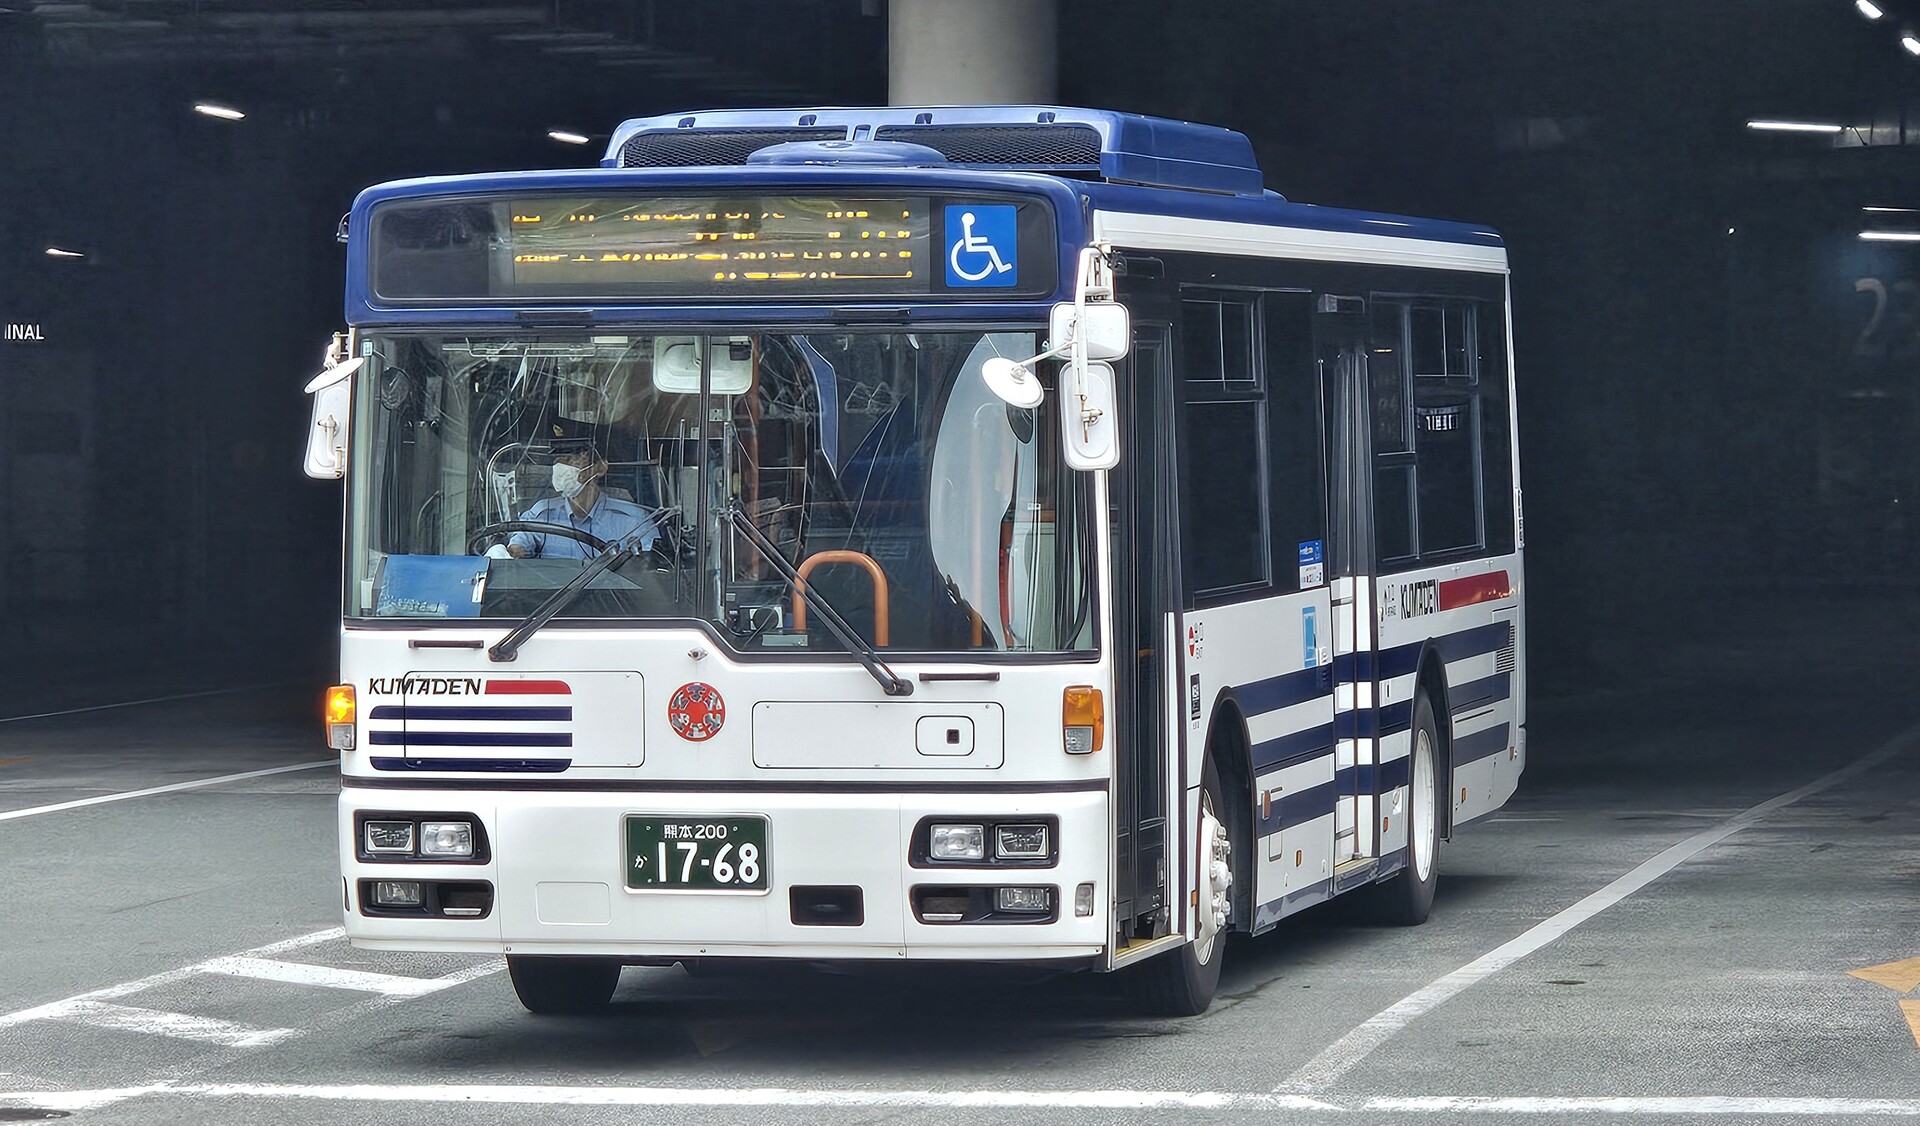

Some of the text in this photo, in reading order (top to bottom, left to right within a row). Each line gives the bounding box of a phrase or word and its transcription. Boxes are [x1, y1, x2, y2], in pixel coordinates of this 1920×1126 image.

[4, 324, 45, 340] INAL
[369, 678, 481, 695] KUMADEN
[634, 842, 760, 884] か 17-68
